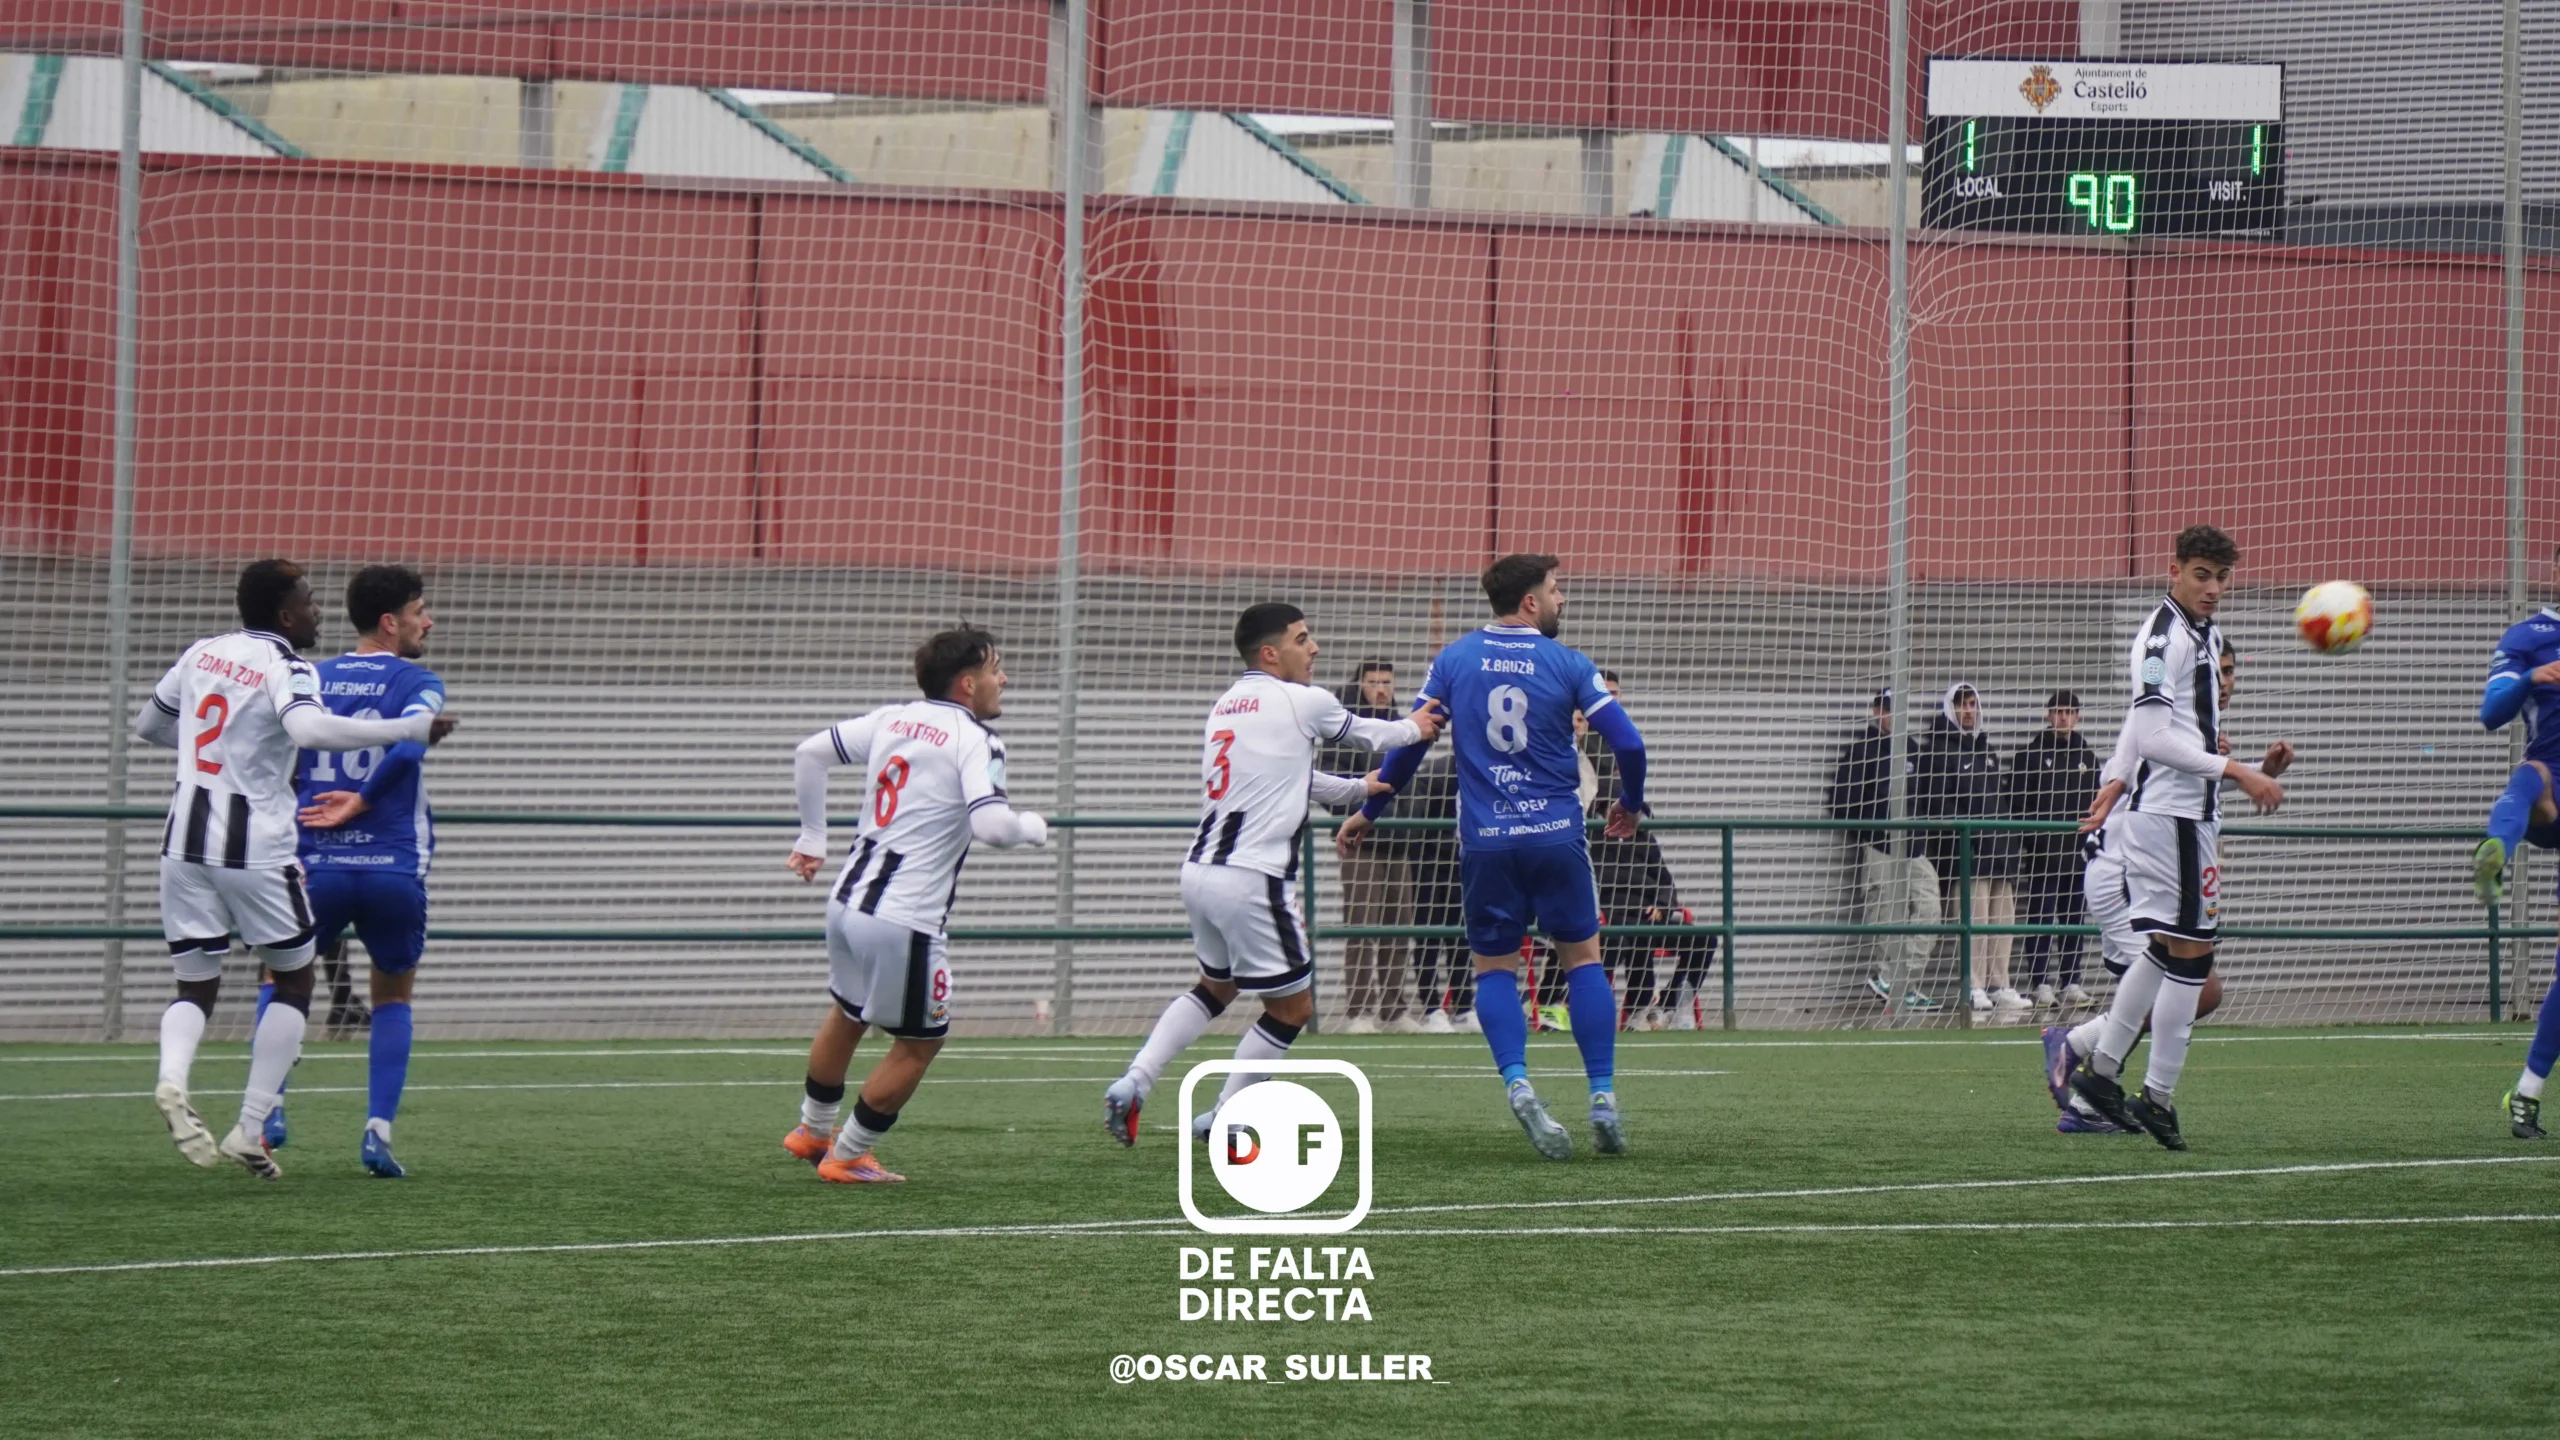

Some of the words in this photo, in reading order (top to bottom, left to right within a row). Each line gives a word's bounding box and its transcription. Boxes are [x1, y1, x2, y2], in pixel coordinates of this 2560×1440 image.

[2074, 80, 2147, 99] Castelló
[2075, 68, 2131, 79] Ajuntament
[2135, 68, 2147, 78] de
[2091, 101, 2128, 114] Esports
[1967, 120, 1975, 171] 1
[2252, 124, 2261, 176] 1
[1956, 177, 2002, 198] LOCAL
[2069, 174, 2135, 231] 90
[2208, 180, 2247, 201] VISIT.
[194, 694, 229, 776] 2
[1486, 684, 1528, 755] 8
[1207, 729, 1235, 800] 3
[875, 755, 910, 828] 8
[1478, 827, 1500, 837] VISIT
[933, 968, 948, 1000] 8
